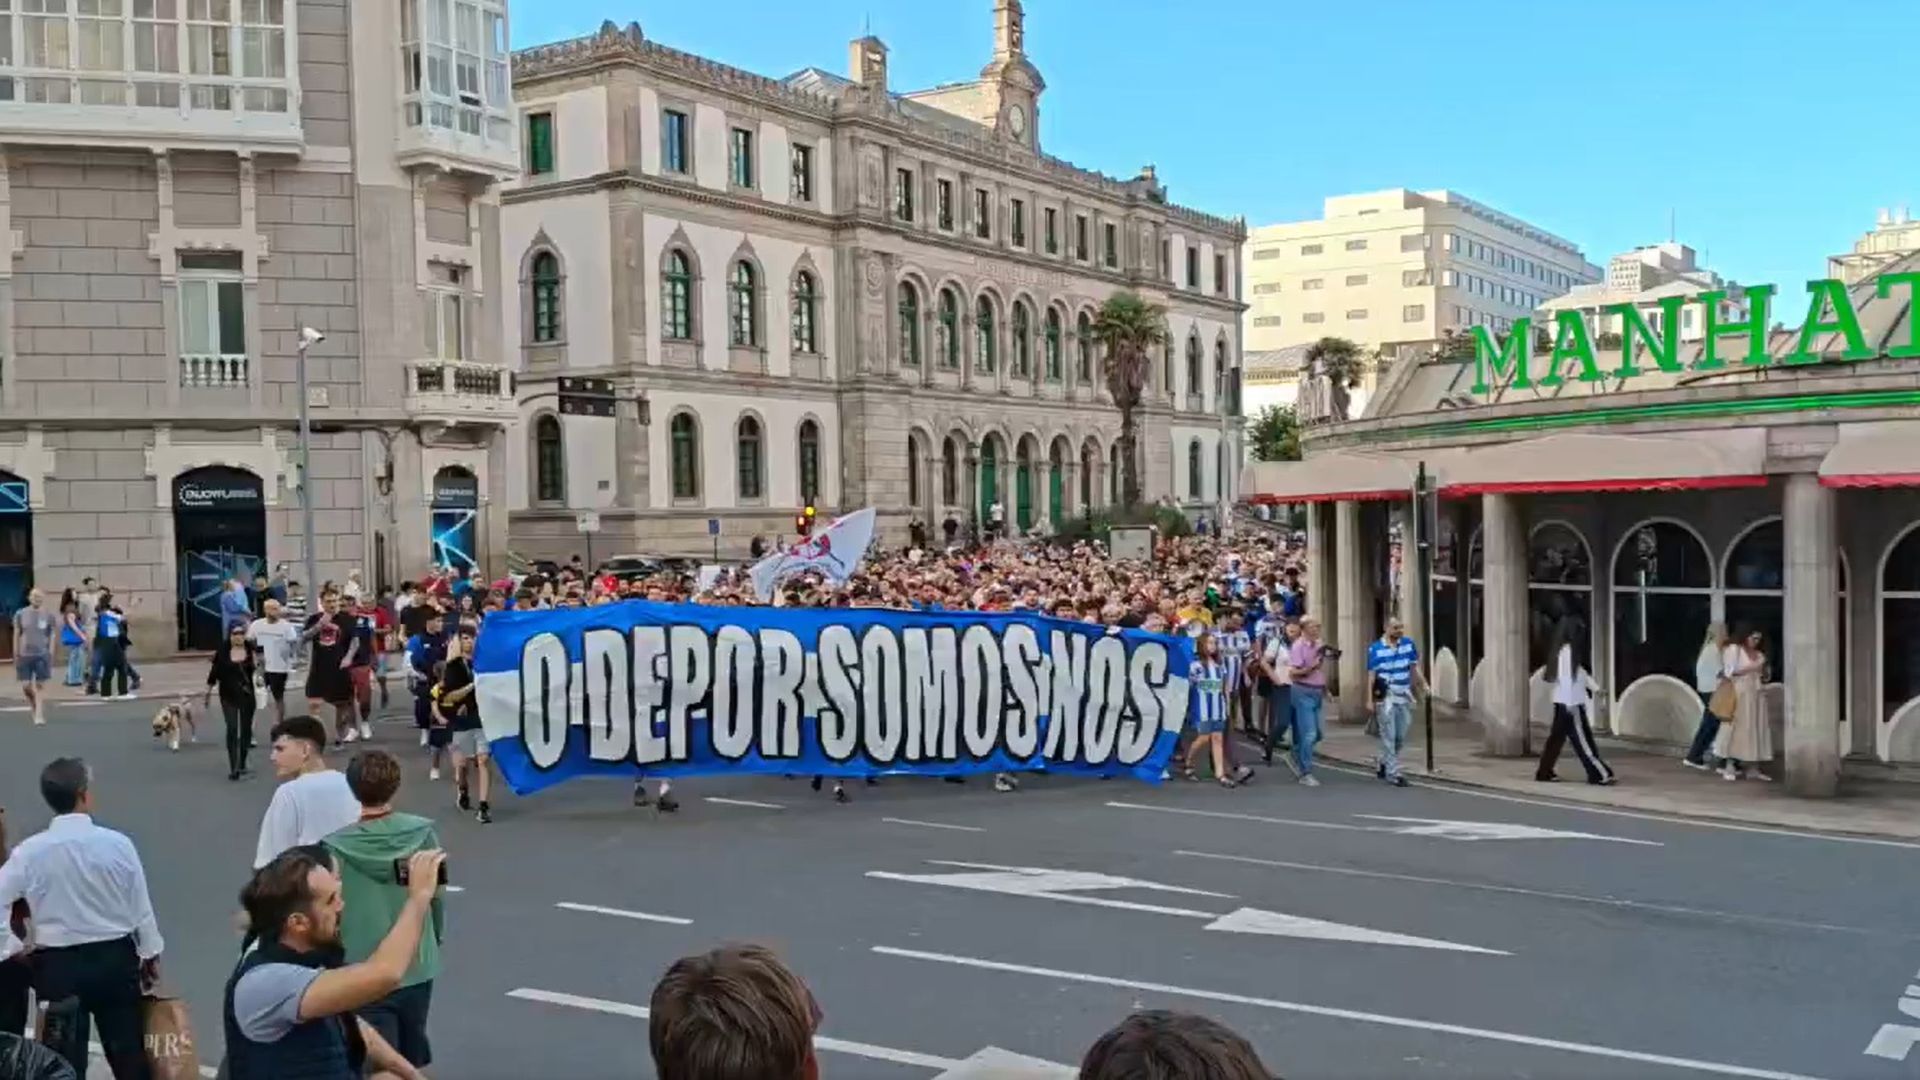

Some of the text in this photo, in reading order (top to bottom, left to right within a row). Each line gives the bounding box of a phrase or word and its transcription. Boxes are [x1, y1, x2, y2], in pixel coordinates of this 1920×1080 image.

[521, 630, 569, 769] O
[582, 624, 803, 765] DEPOR
[817, 622, 1042, 763] SOMOS
